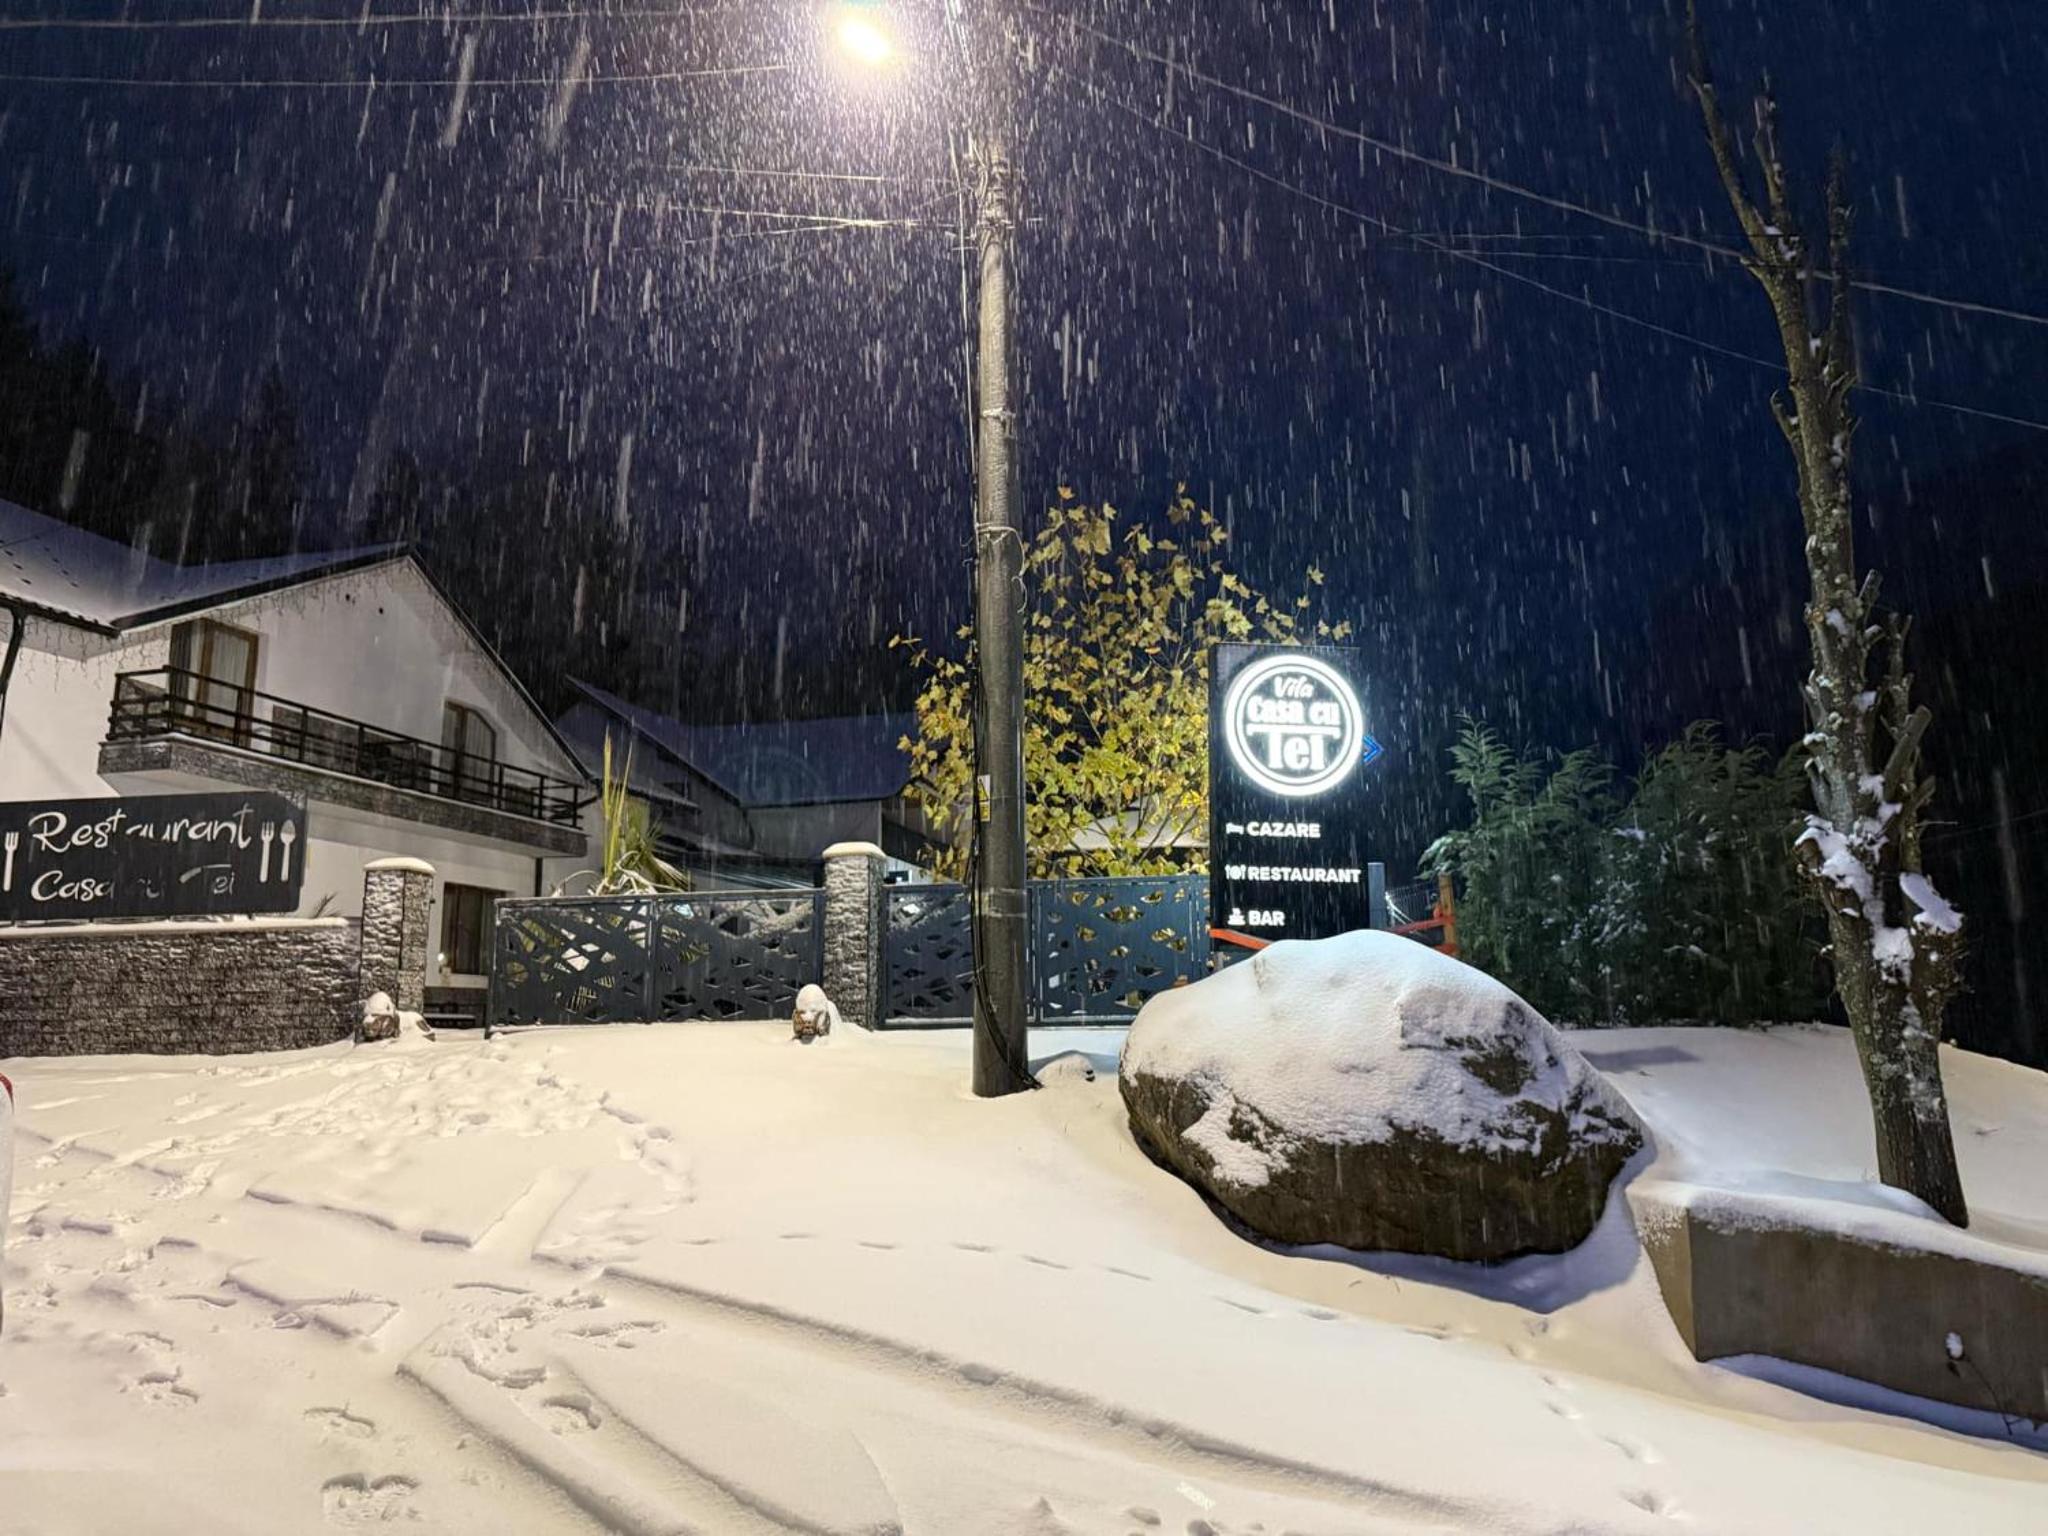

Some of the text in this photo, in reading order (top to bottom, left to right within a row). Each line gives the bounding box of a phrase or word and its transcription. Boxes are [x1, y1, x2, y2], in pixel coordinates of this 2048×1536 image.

[1274, 675, 1314, 698] Vila
[1247, 822, 1321, 838] CAZARE
[1247, 866, 1361, 883] RESTAURANT
[30, 870, 115, 901] Casa
[1248, 910, 1285, 926] BAR
